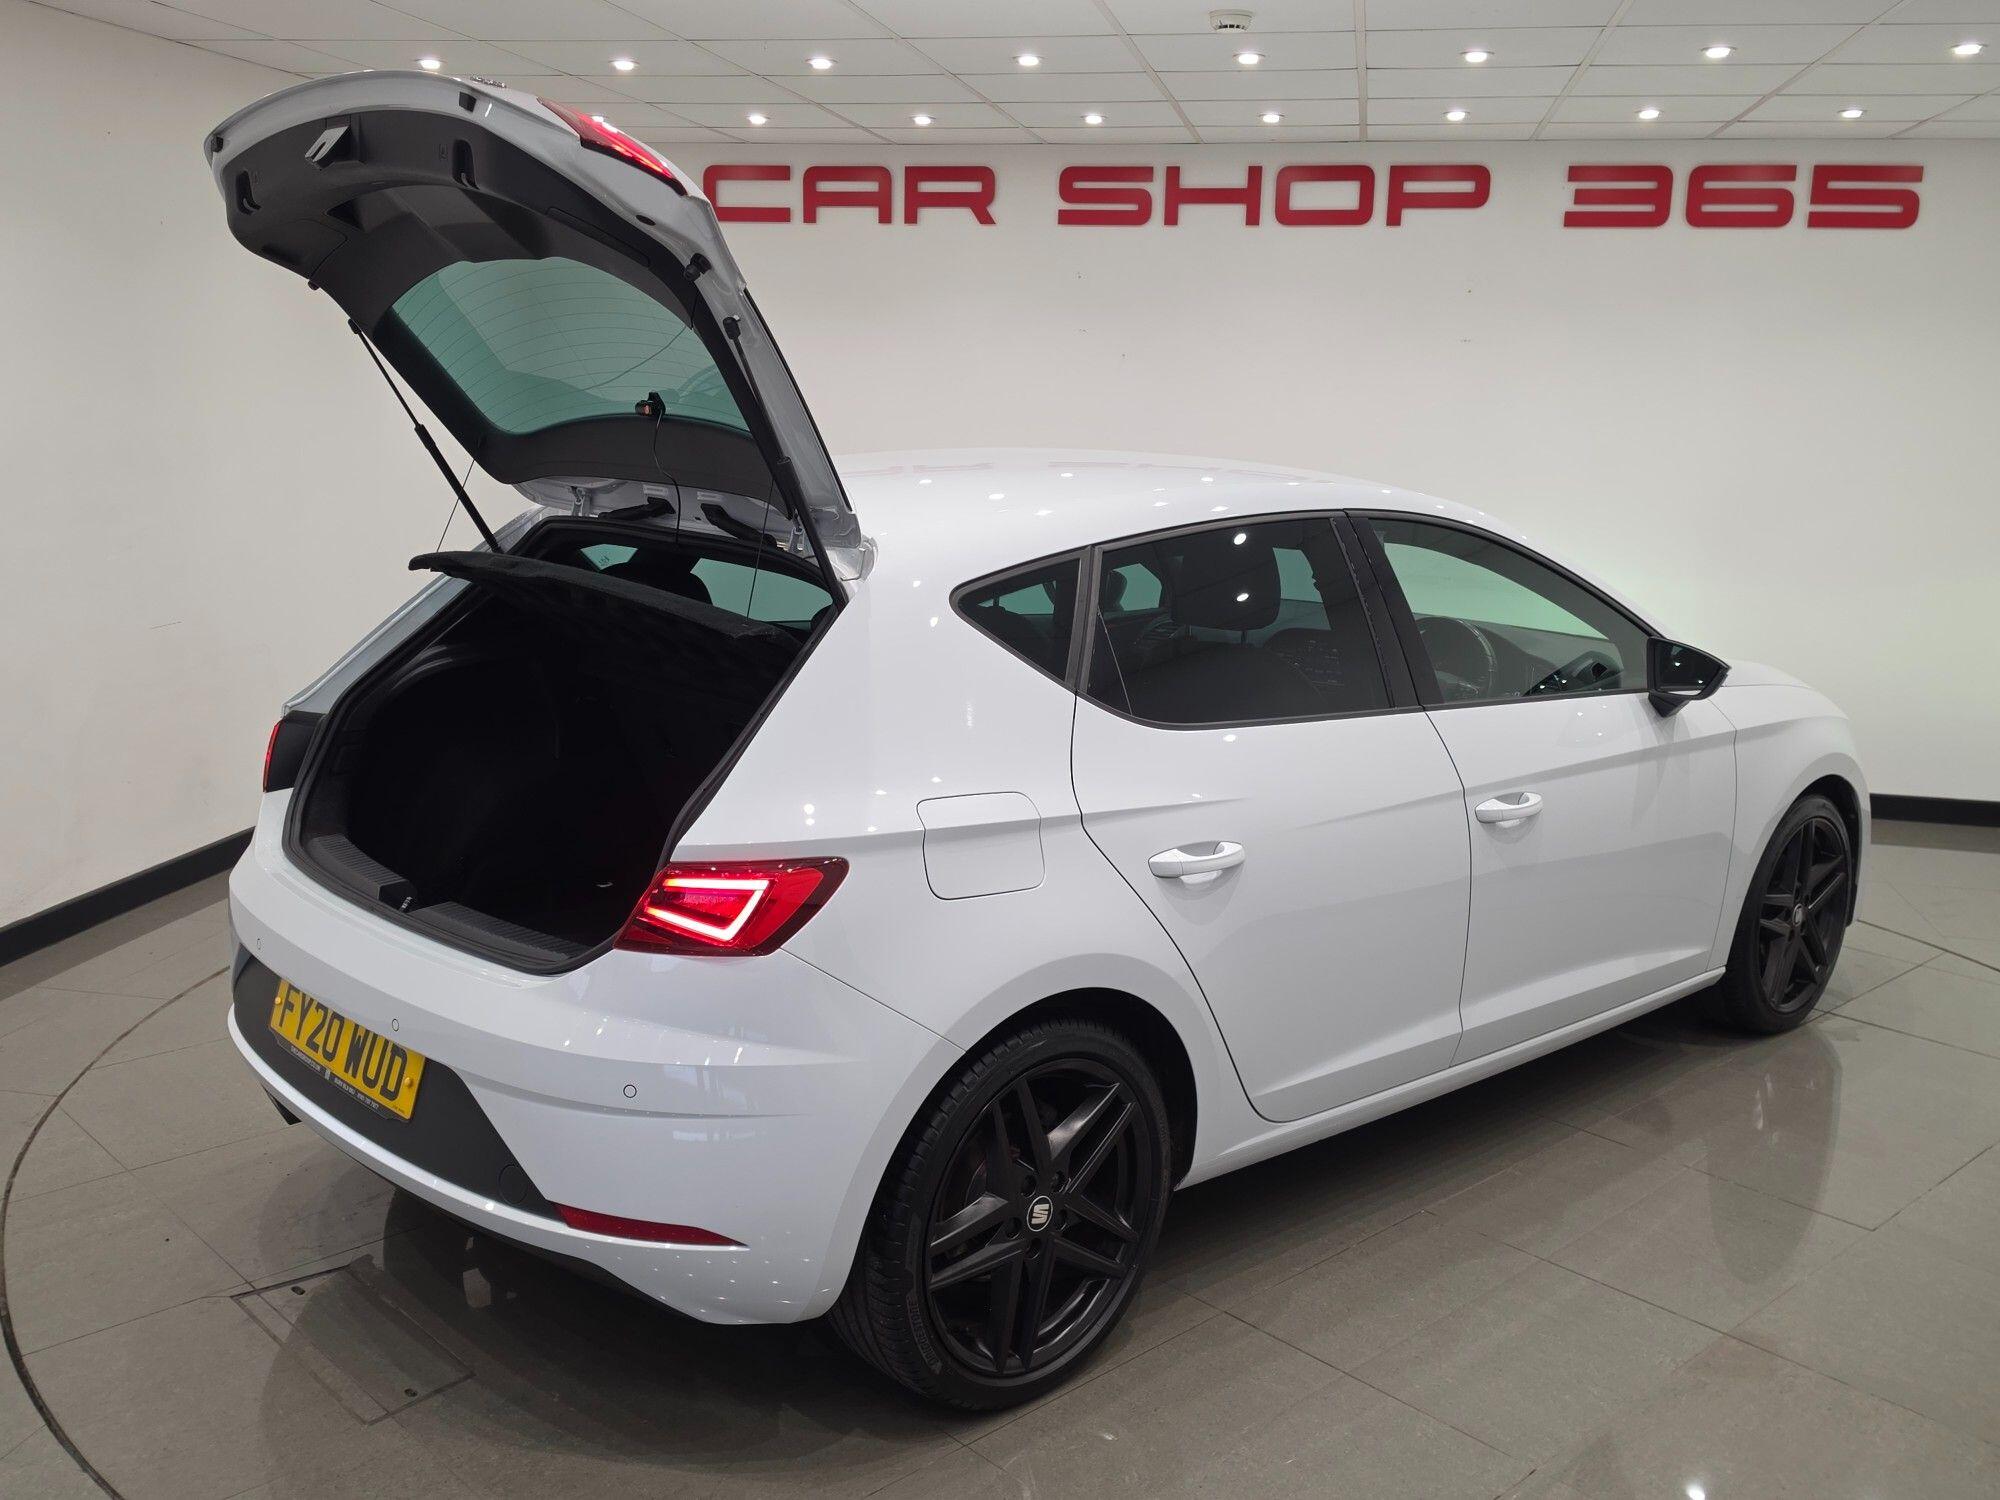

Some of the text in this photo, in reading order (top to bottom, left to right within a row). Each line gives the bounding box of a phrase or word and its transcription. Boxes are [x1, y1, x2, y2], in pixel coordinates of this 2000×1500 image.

[703, 165, 1921, 229] CAR SHOP 365
[279, 985, 345, 1063] FY20
[344, 1024, 408, 1102] WUD
